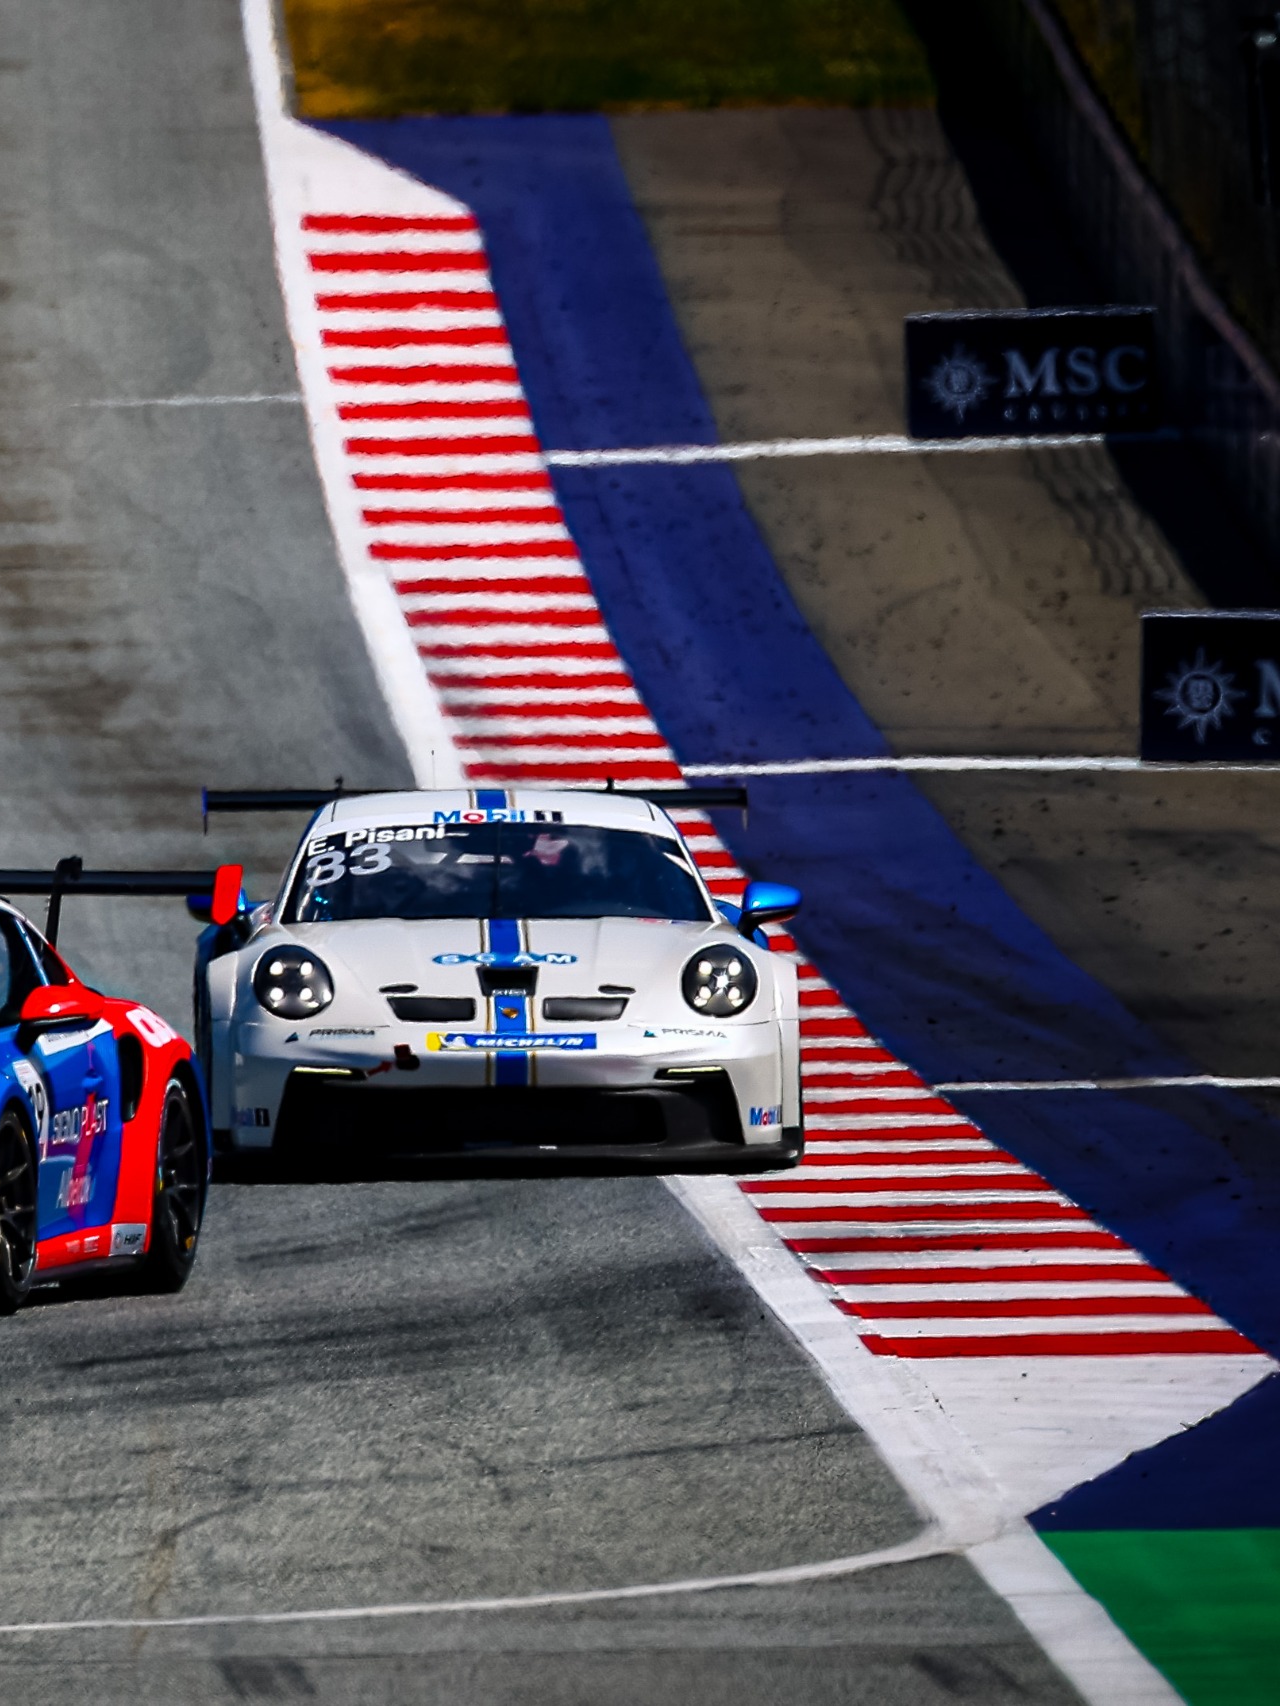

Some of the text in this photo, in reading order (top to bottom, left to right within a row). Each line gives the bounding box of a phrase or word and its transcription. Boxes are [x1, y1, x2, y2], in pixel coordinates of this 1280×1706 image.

[1003, 346, 1148, 397] MSC
[433, 810, 525, 823] Mobil
[308, 824, 446, 856] E. Pisani
[306, 843, 393, 887] 83
[475, 1037, 584, 1048] MICHELIN
